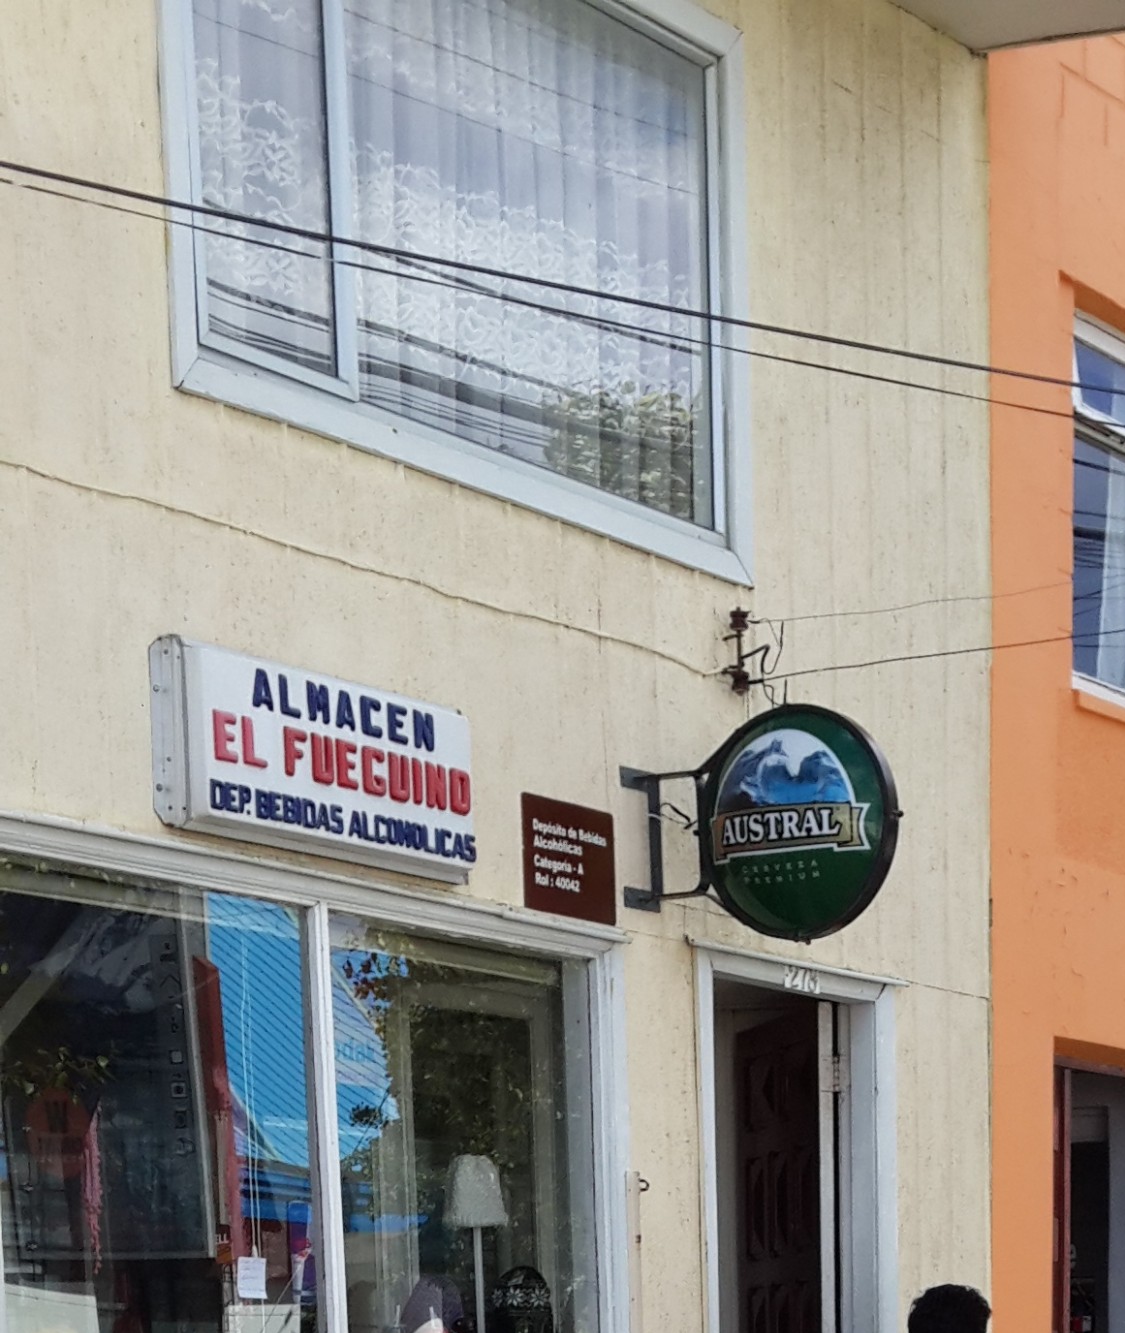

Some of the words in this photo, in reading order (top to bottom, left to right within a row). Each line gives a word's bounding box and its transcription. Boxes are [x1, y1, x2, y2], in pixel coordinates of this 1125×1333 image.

[252, 667, 435, 752] ALMACEN
[212, 708, 269, 769] EL
[283, 725, 472, 817] FUEGUINO
[209, 778, 252, 816] DEP.
[254, 787, 344, 835] BEBIDAS
[348, 809, 478, 864] ALCOHOLICAS
[721, 808, 842, 846] AUSTRAL
[567, 826, 578, 840] de
[578, 828, 608, 848] Bebidas
[577, 862, 585, 876] A
[741, 858, 819, 874] CERVEZA
[534, 871, 549, 888] Rol
[743, 870, 821, 885] PREMIUM
